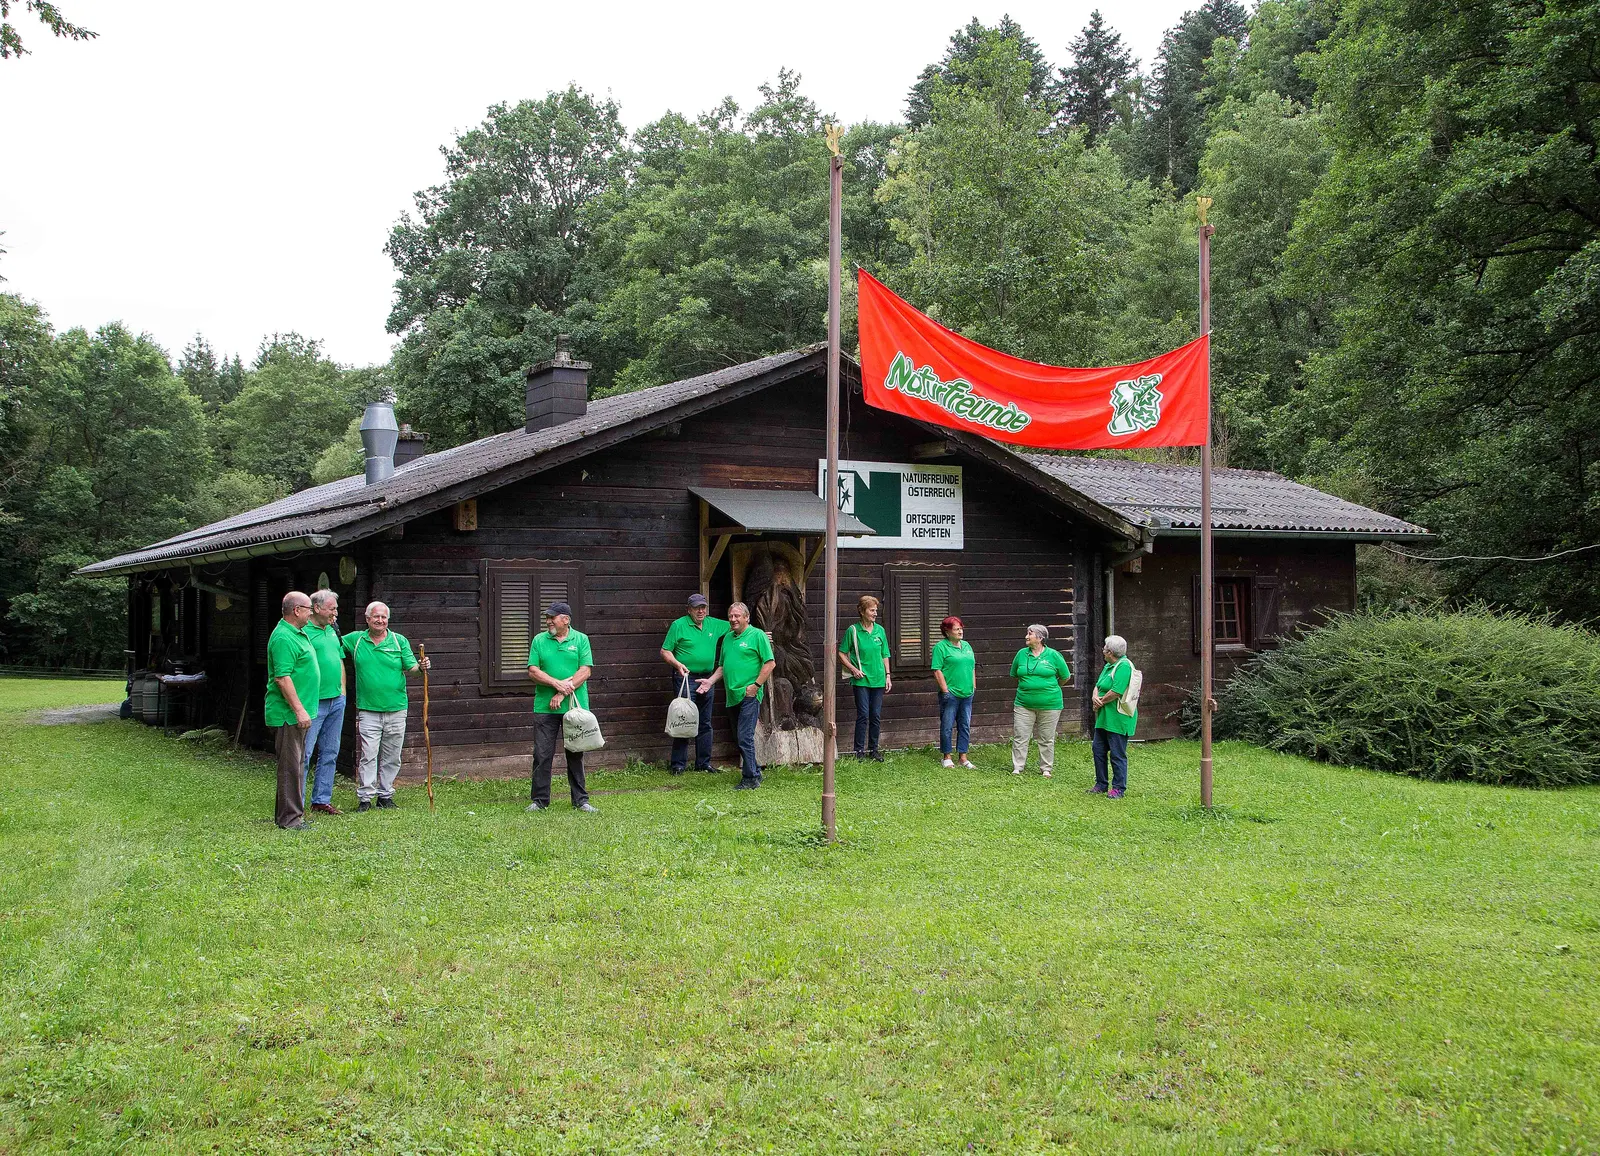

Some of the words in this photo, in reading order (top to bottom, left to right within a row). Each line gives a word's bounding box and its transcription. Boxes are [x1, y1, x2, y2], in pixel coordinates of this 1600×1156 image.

[885, 351, 1031, 432] Naturfreunde
[902, 473, 959, 485] NATURFREUNDE
[908, 485, 955, 497] ÖSTERREICH
[906, 514, 956, 524] ORTSGRUPPE
[912, 528, 951, 538] KEMETEN
